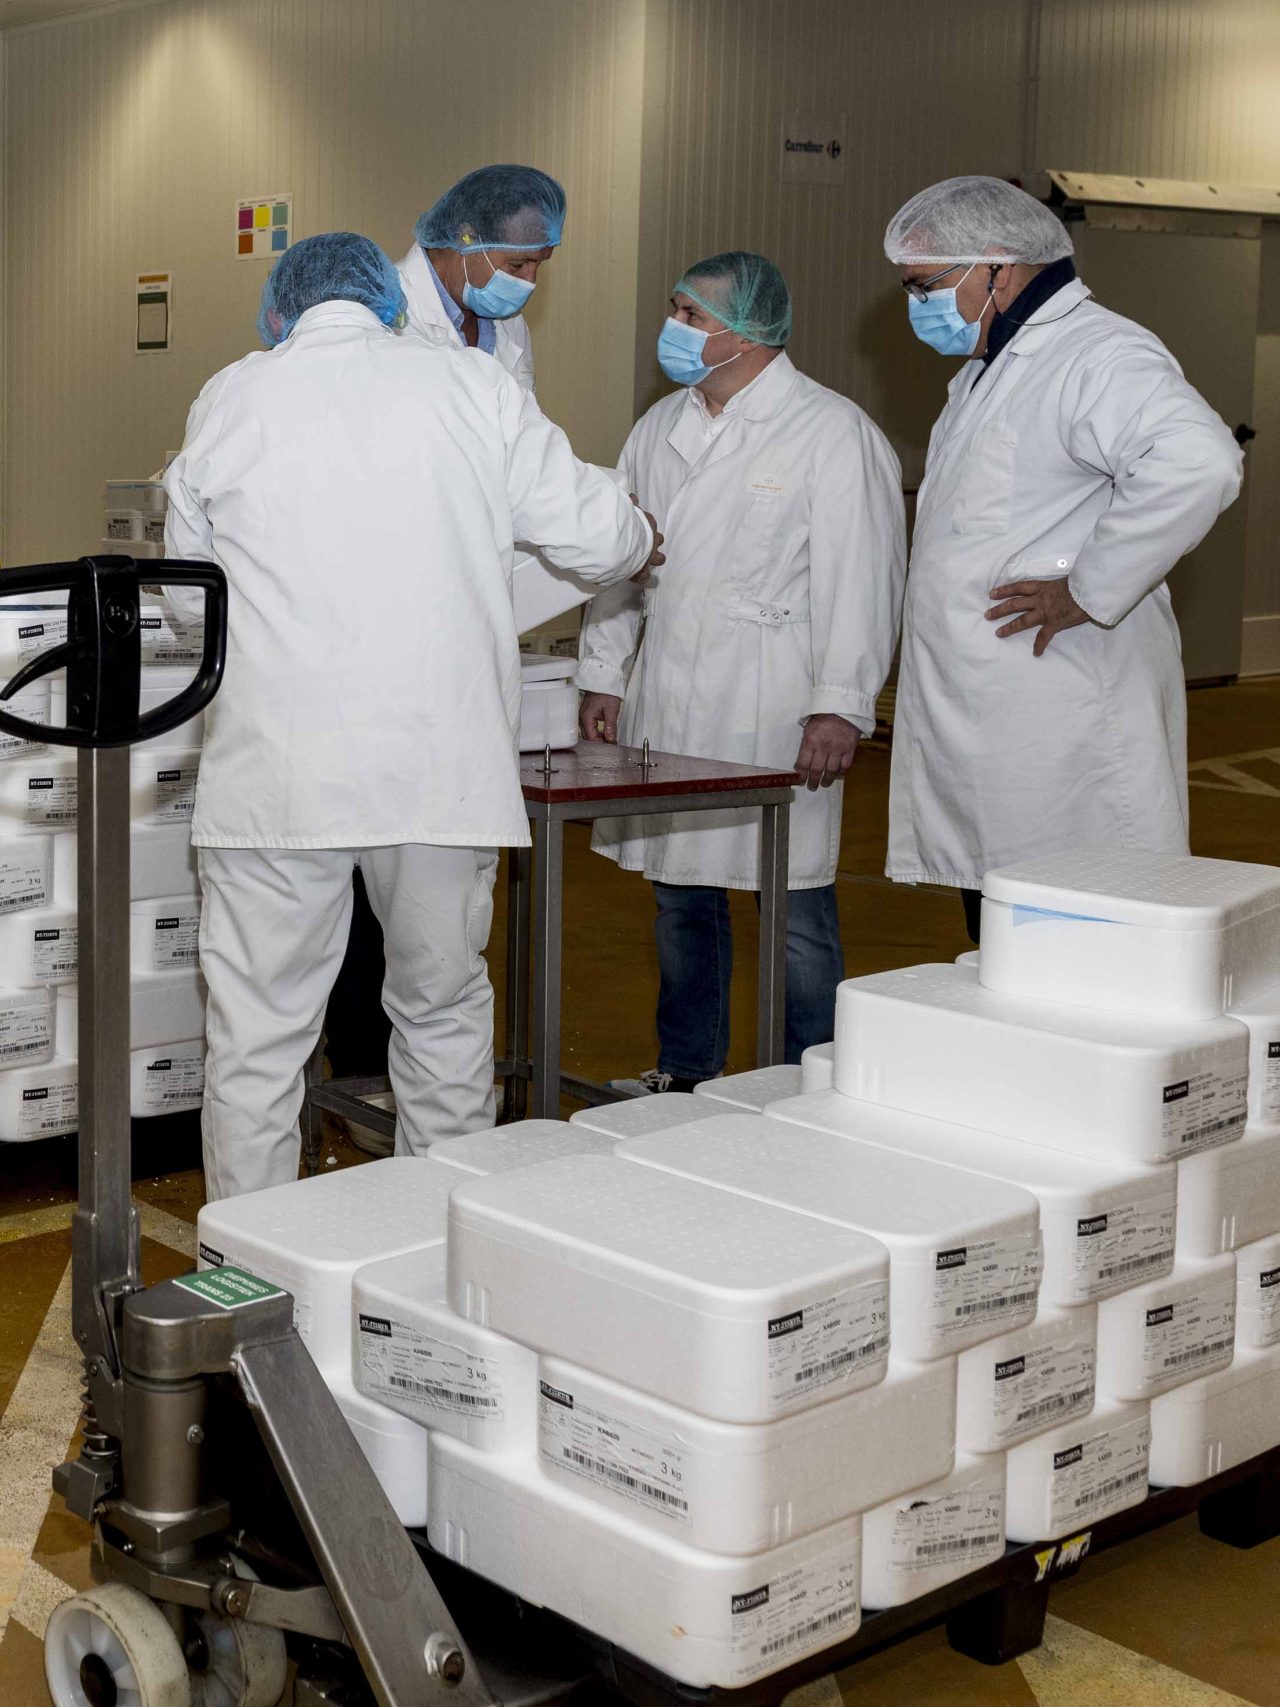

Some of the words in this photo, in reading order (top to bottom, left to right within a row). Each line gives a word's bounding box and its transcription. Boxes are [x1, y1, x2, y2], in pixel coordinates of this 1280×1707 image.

[784, 139, 824, 153] Carrefour
[467, 1367, 474, 1379] 3
[476, 1370, 487, 1382] kg
[661, 1461, 668, 1474] 3
[670, 1467, 682, 1482] kg
